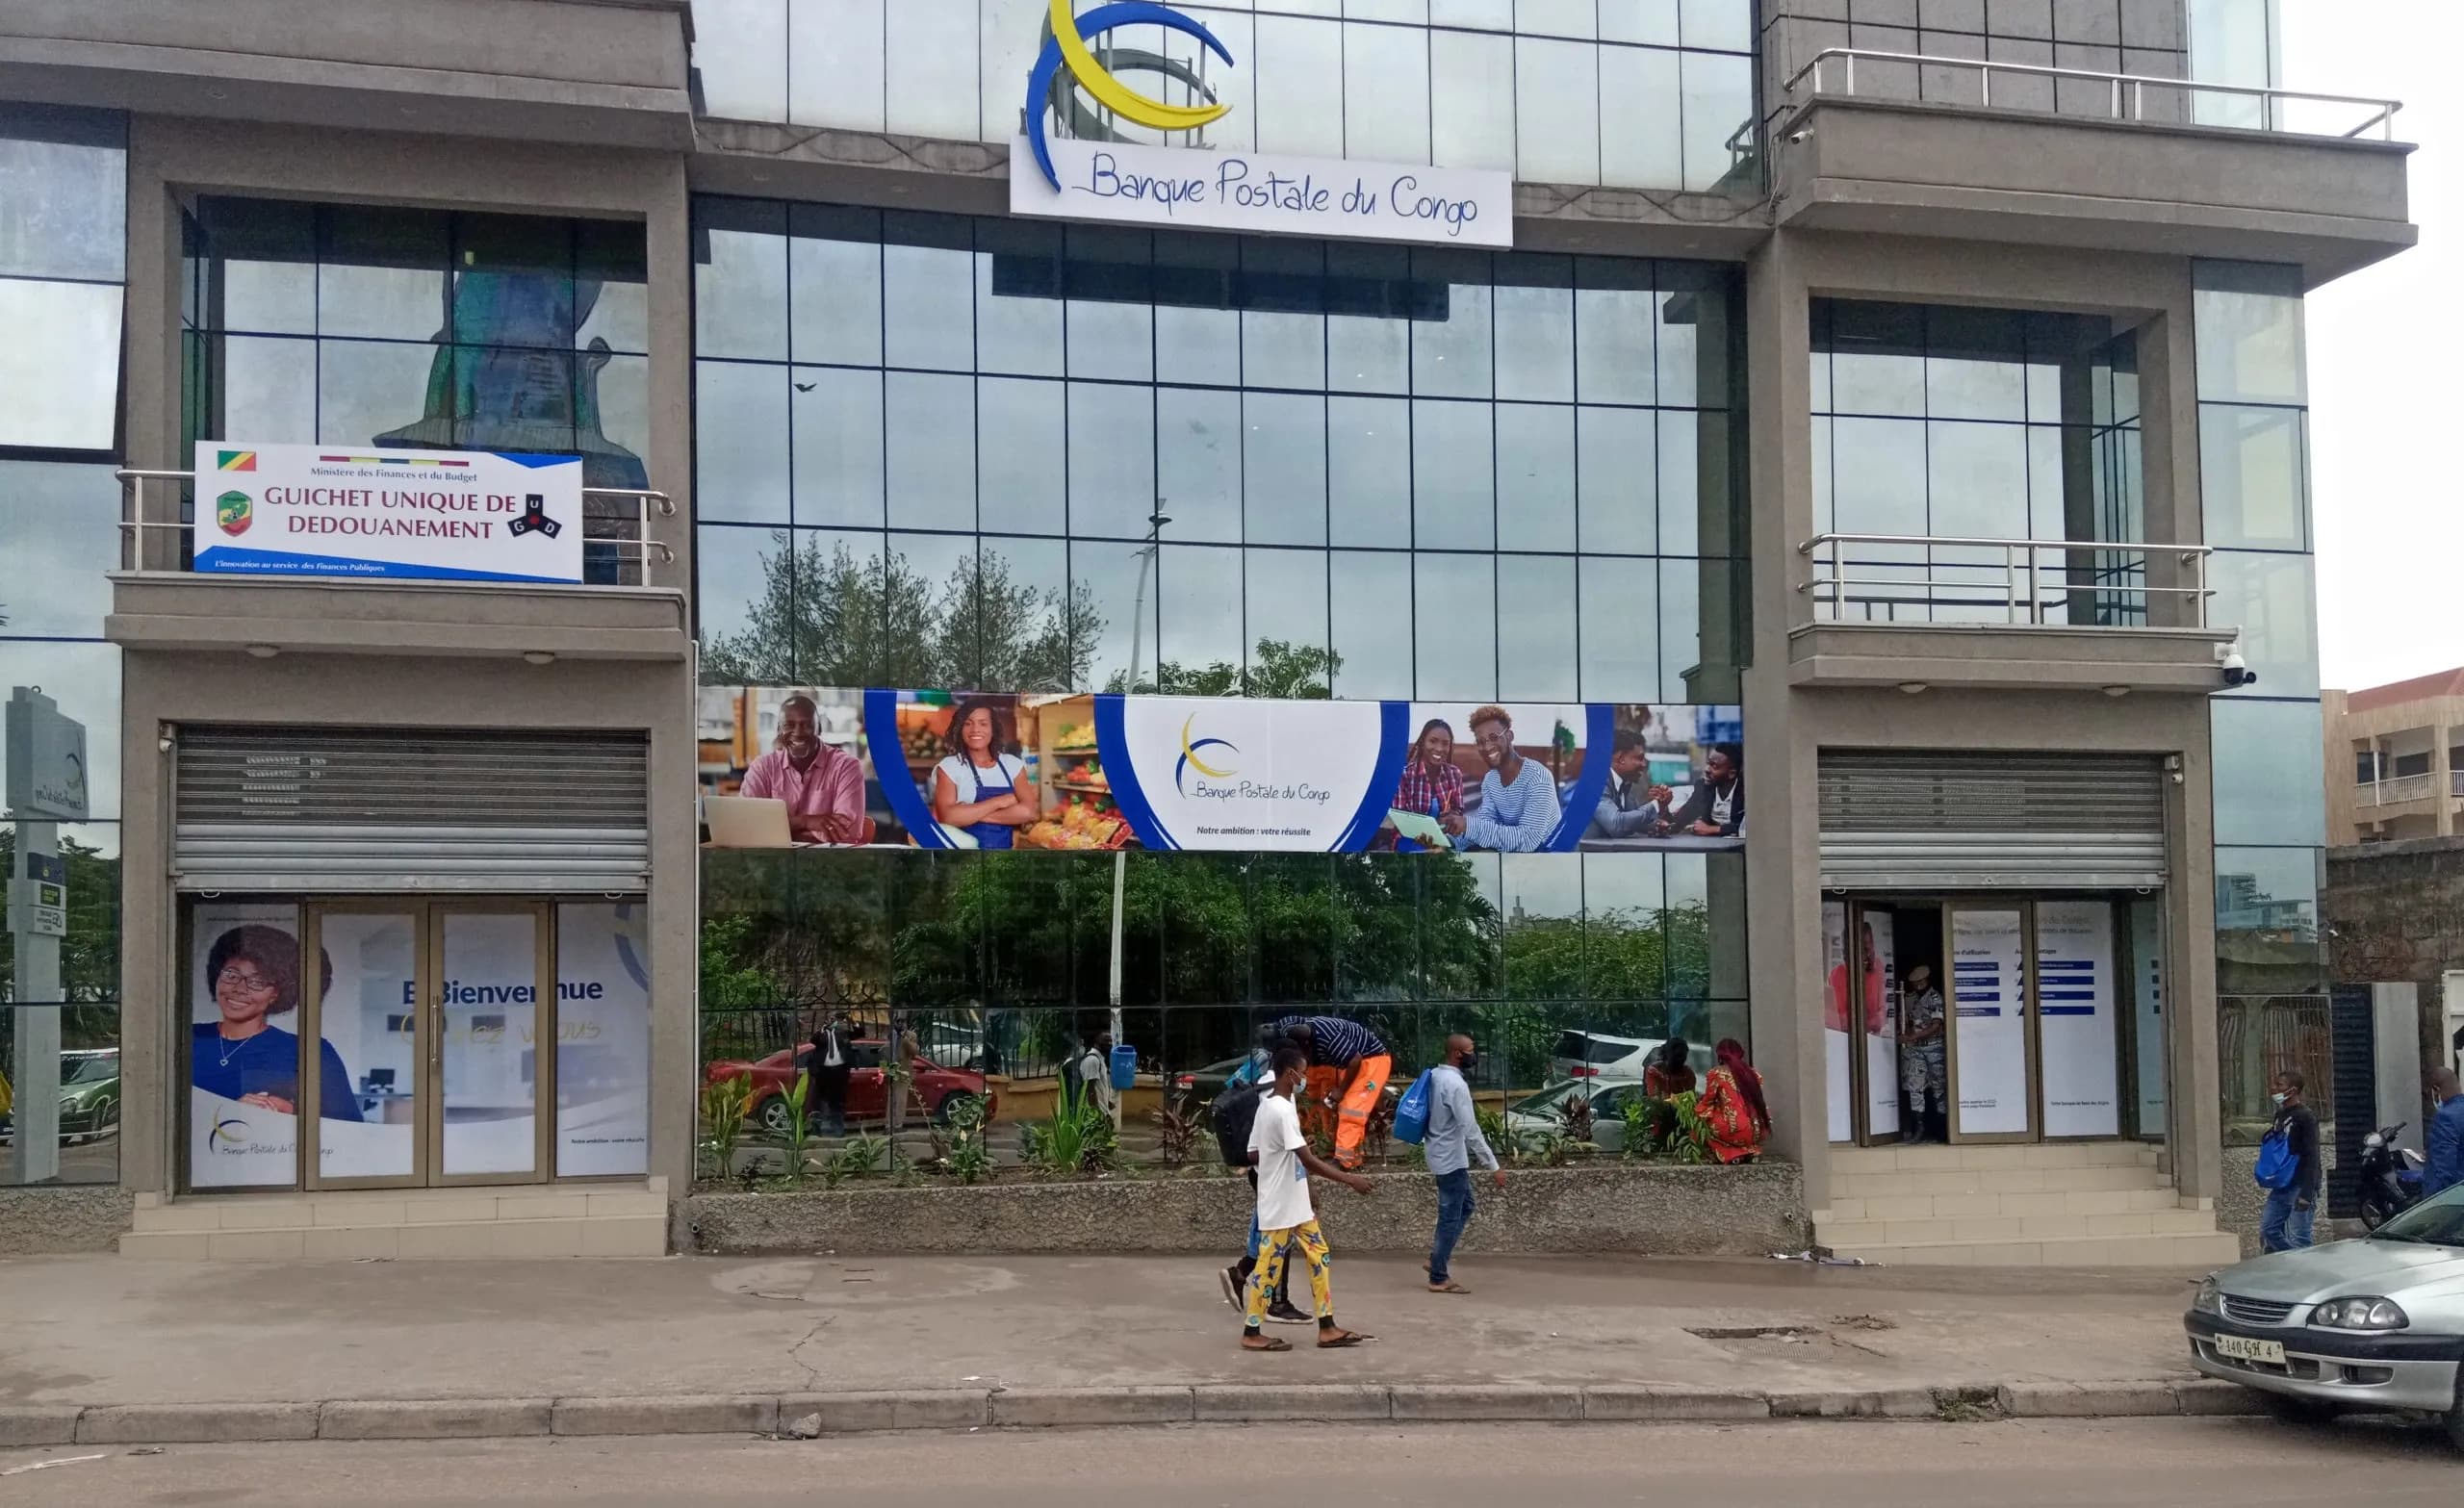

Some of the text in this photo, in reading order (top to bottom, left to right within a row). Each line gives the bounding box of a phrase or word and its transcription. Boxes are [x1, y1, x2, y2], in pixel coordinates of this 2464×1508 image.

[1072, 151, 1477, 237] Banque Postale du Congo
[358, 469, 373, 477] des
[375, 469, 416, 479] Finances
[418, 472, 427, 480] et
[430, 471, 443, 480] du
[445, 472, 477, 483] Budget
[264, 487, 516, 514] GUICHET UNIQUE DE
[529, 499, 539, 509] U
[288, 515, 494, 539] DEDOUANEMENT
[513, 521, 525, 532] G
[544, 523, 555, 533] D
[272, 561, 298, 570] service
[301, 561, 314, 570] des
[316, 562, 347, 571] Finances
[349, 563, 385, 573] Publiques
[1190, 780, 1331, 805] Banque Postale du Congo
[1196, 826, 1219, 835] Notre
[1220, 826, 1255, 835] ambition
[1261, 828, 1280, 836] votre
[1281, 827, 1311, 836] réussite
